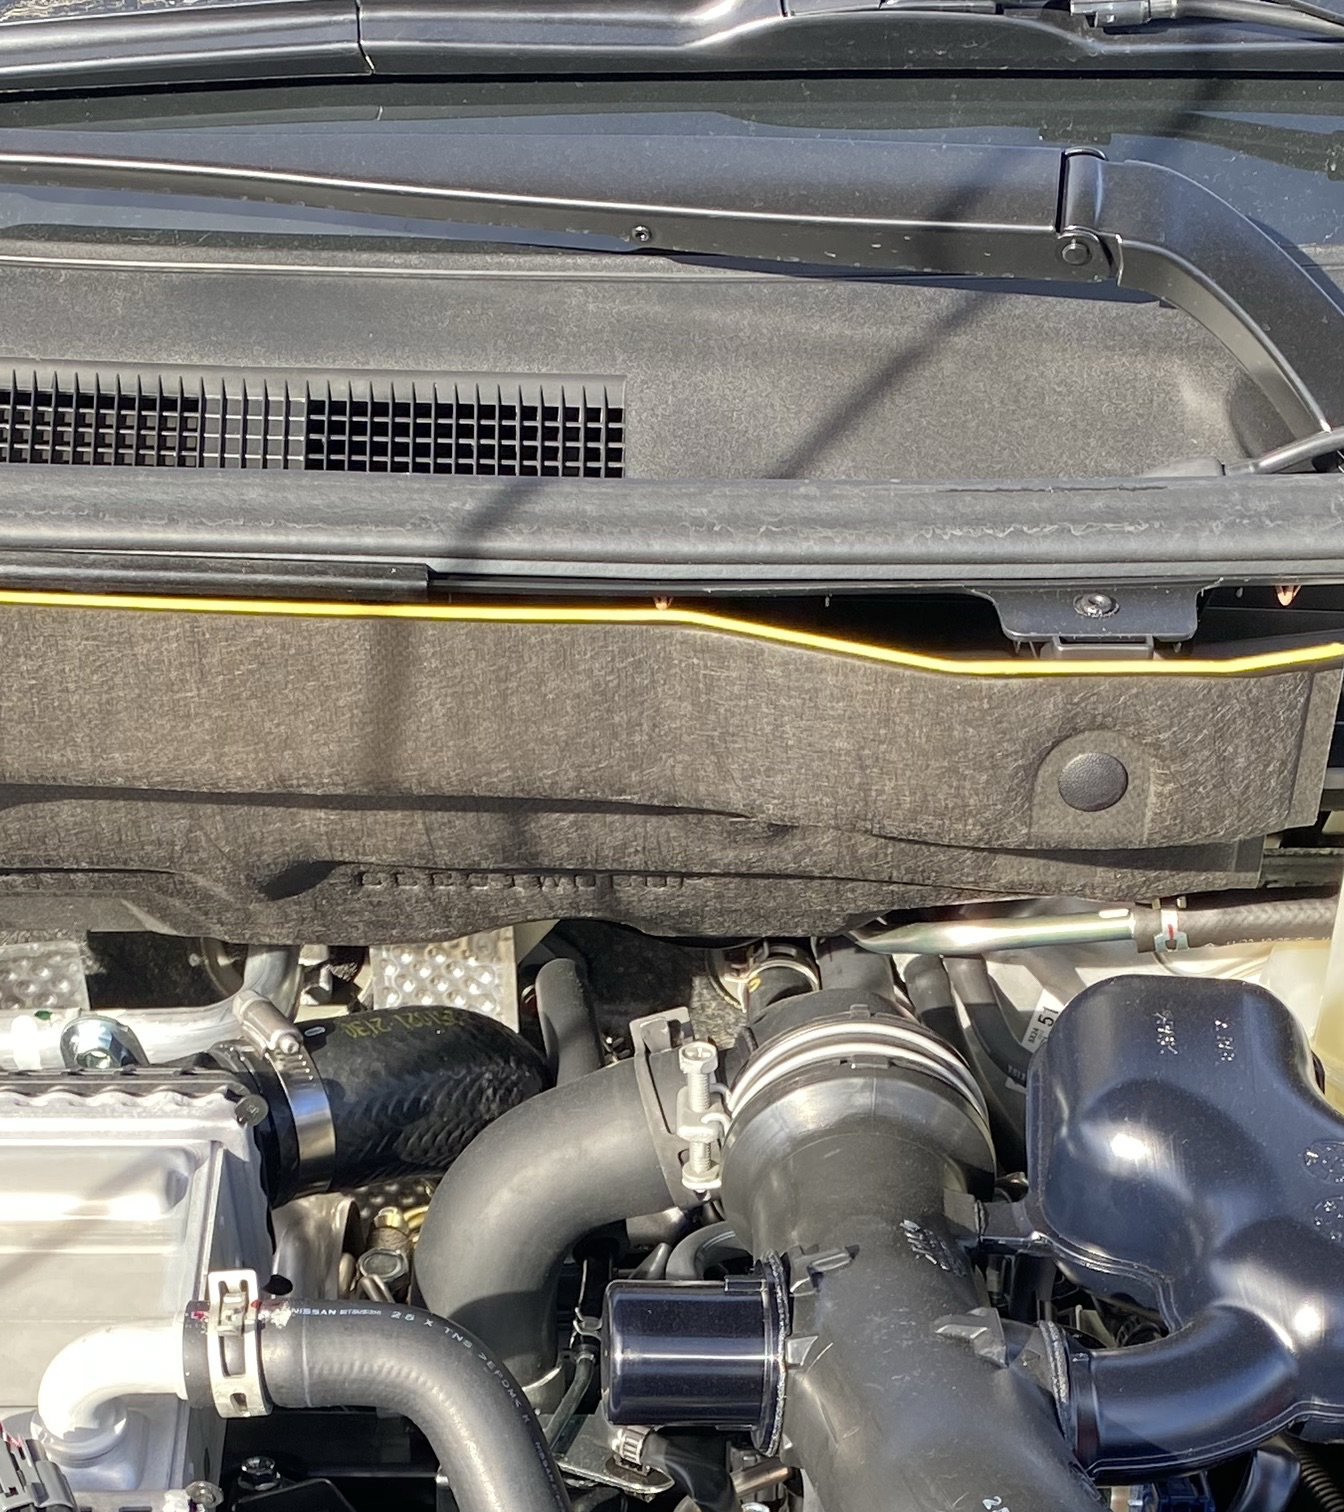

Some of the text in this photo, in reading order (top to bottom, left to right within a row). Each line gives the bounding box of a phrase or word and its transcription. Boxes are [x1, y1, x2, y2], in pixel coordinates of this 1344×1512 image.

[291, 1307, 337, 1317] NISSAN
[423, 1318, 435, 1328] X
[443, 1326, 474, 1350] TNS
